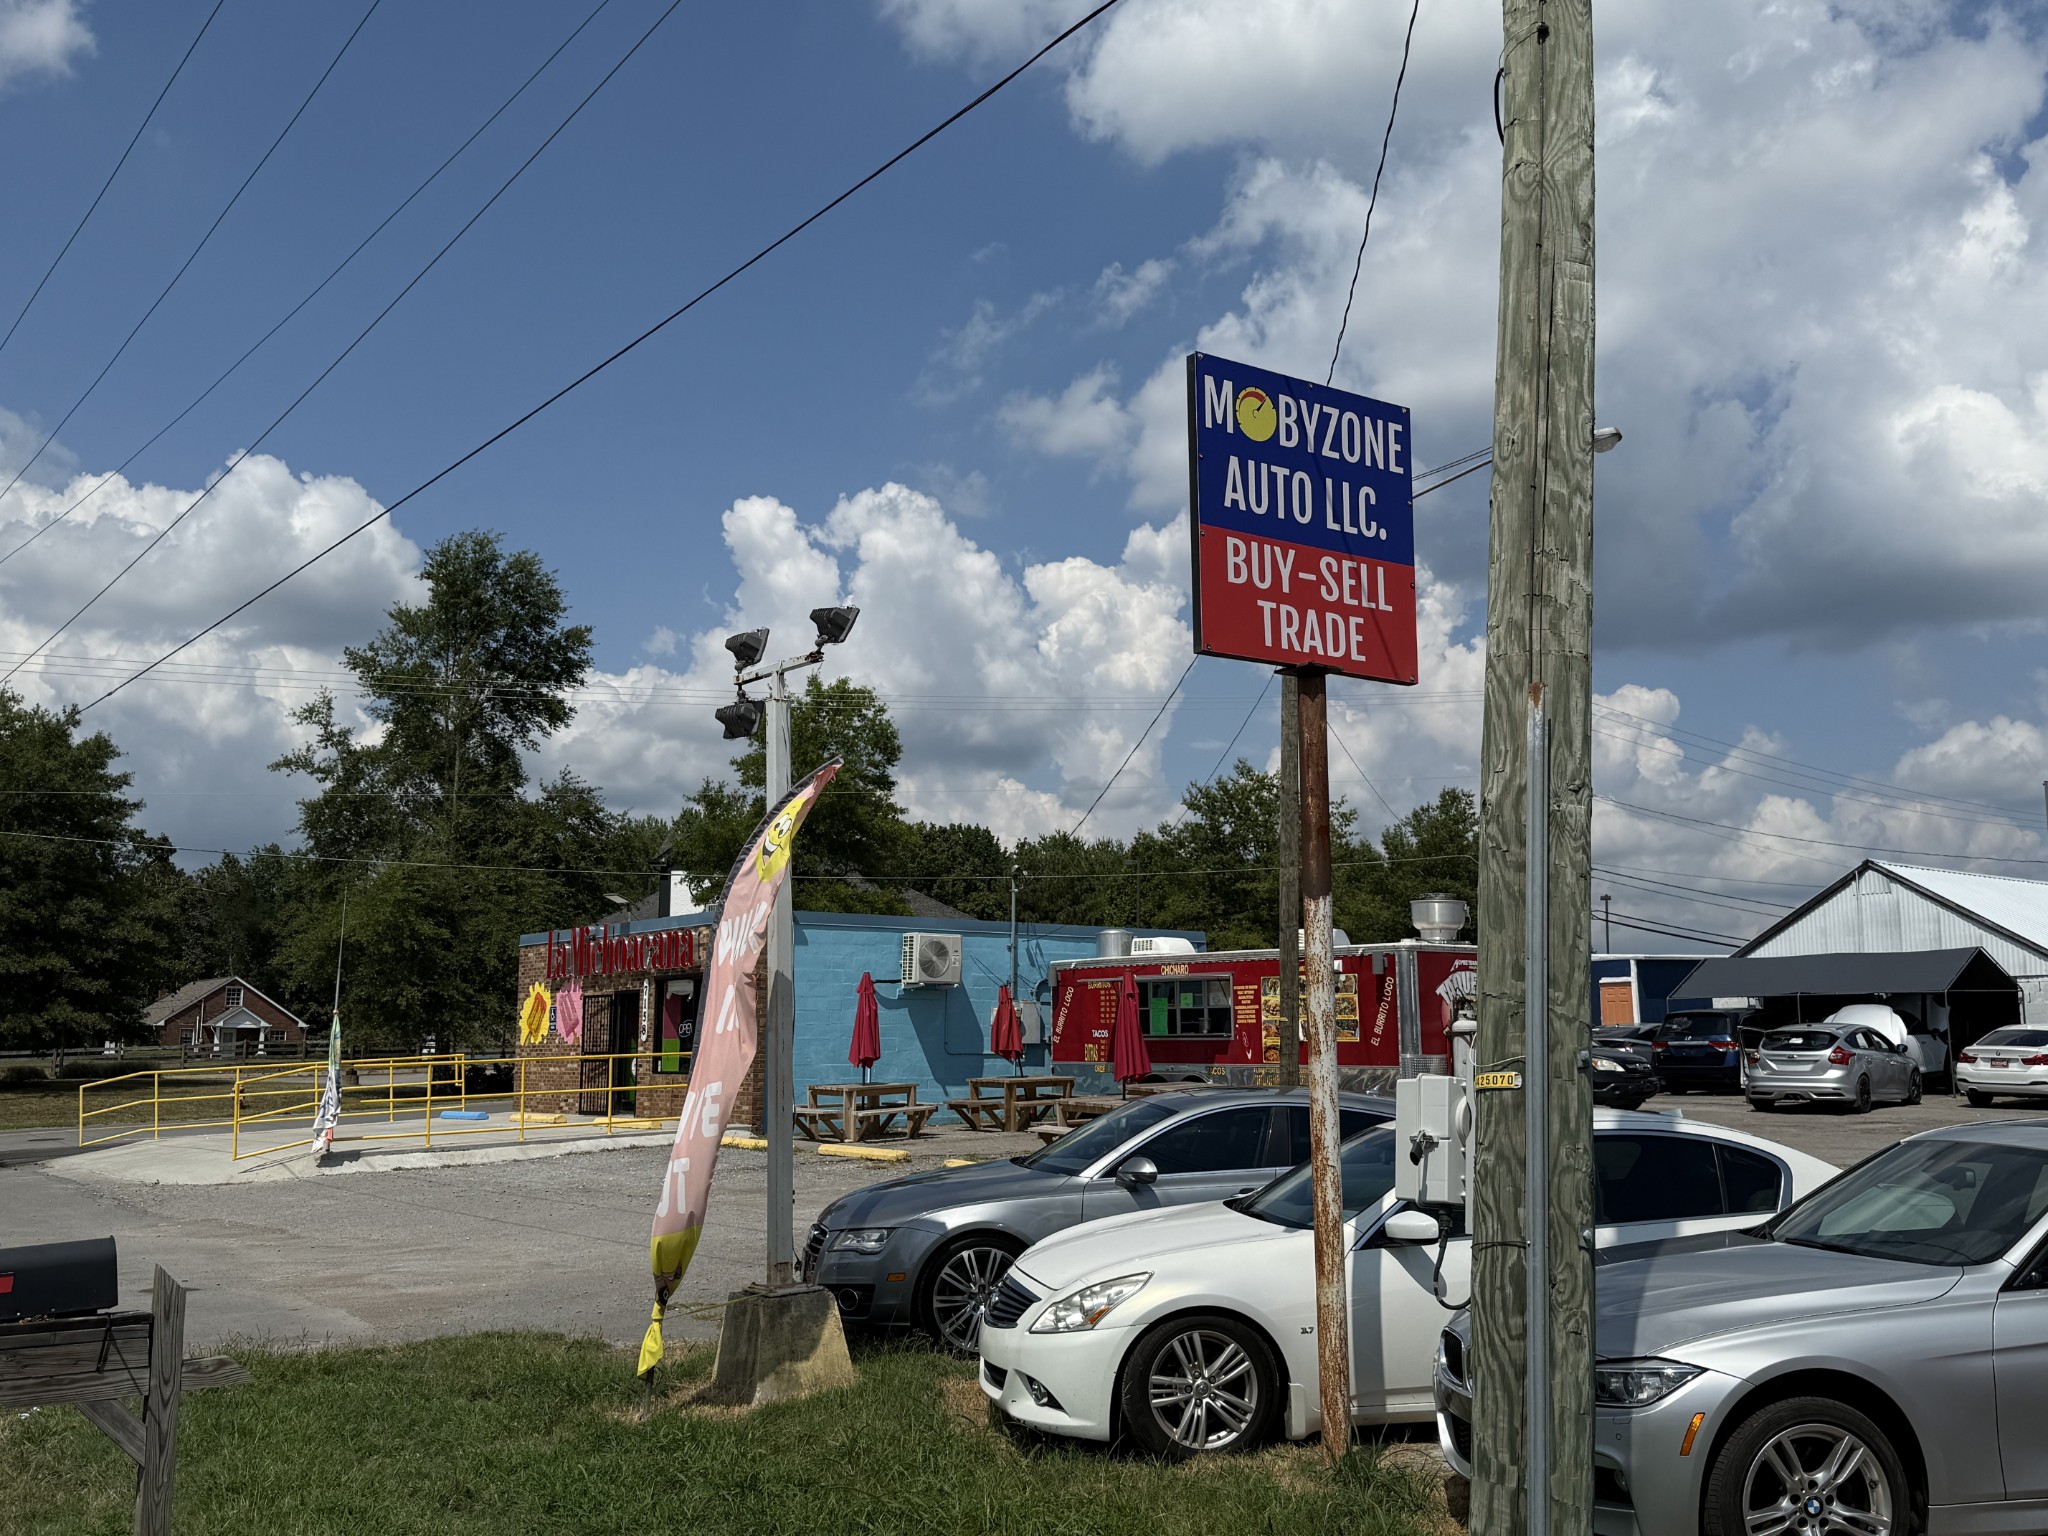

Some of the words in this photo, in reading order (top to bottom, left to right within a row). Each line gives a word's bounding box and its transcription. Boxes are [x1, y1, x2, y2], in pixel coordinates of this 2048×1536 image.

[1223, 455, 1313, 525] AUTO
[1325, 477, 1387, 541] LLC.
[1226, 536, 1393, 612] BUY-SELL
[1256, 599, 1366, 661] TRADE
[546, 930, 567, 979] La
[571, 923, 694, 977] Michoacana
[1063, 986, 1075, 1007] LOCO
[1382, 976, 1395, 1002] LOCO
[1055, 1007, 1068, 1035] BURRITO
[1373, 1002, 1389, 1035] BURRITO
[1053, 1035, 1060, 1044] EL
[1091, 1029, 1109, 1038] TACOS
[1370, 1036, 1380, 1047] EL
[1476, 1074, 1514, 1087] 425070
